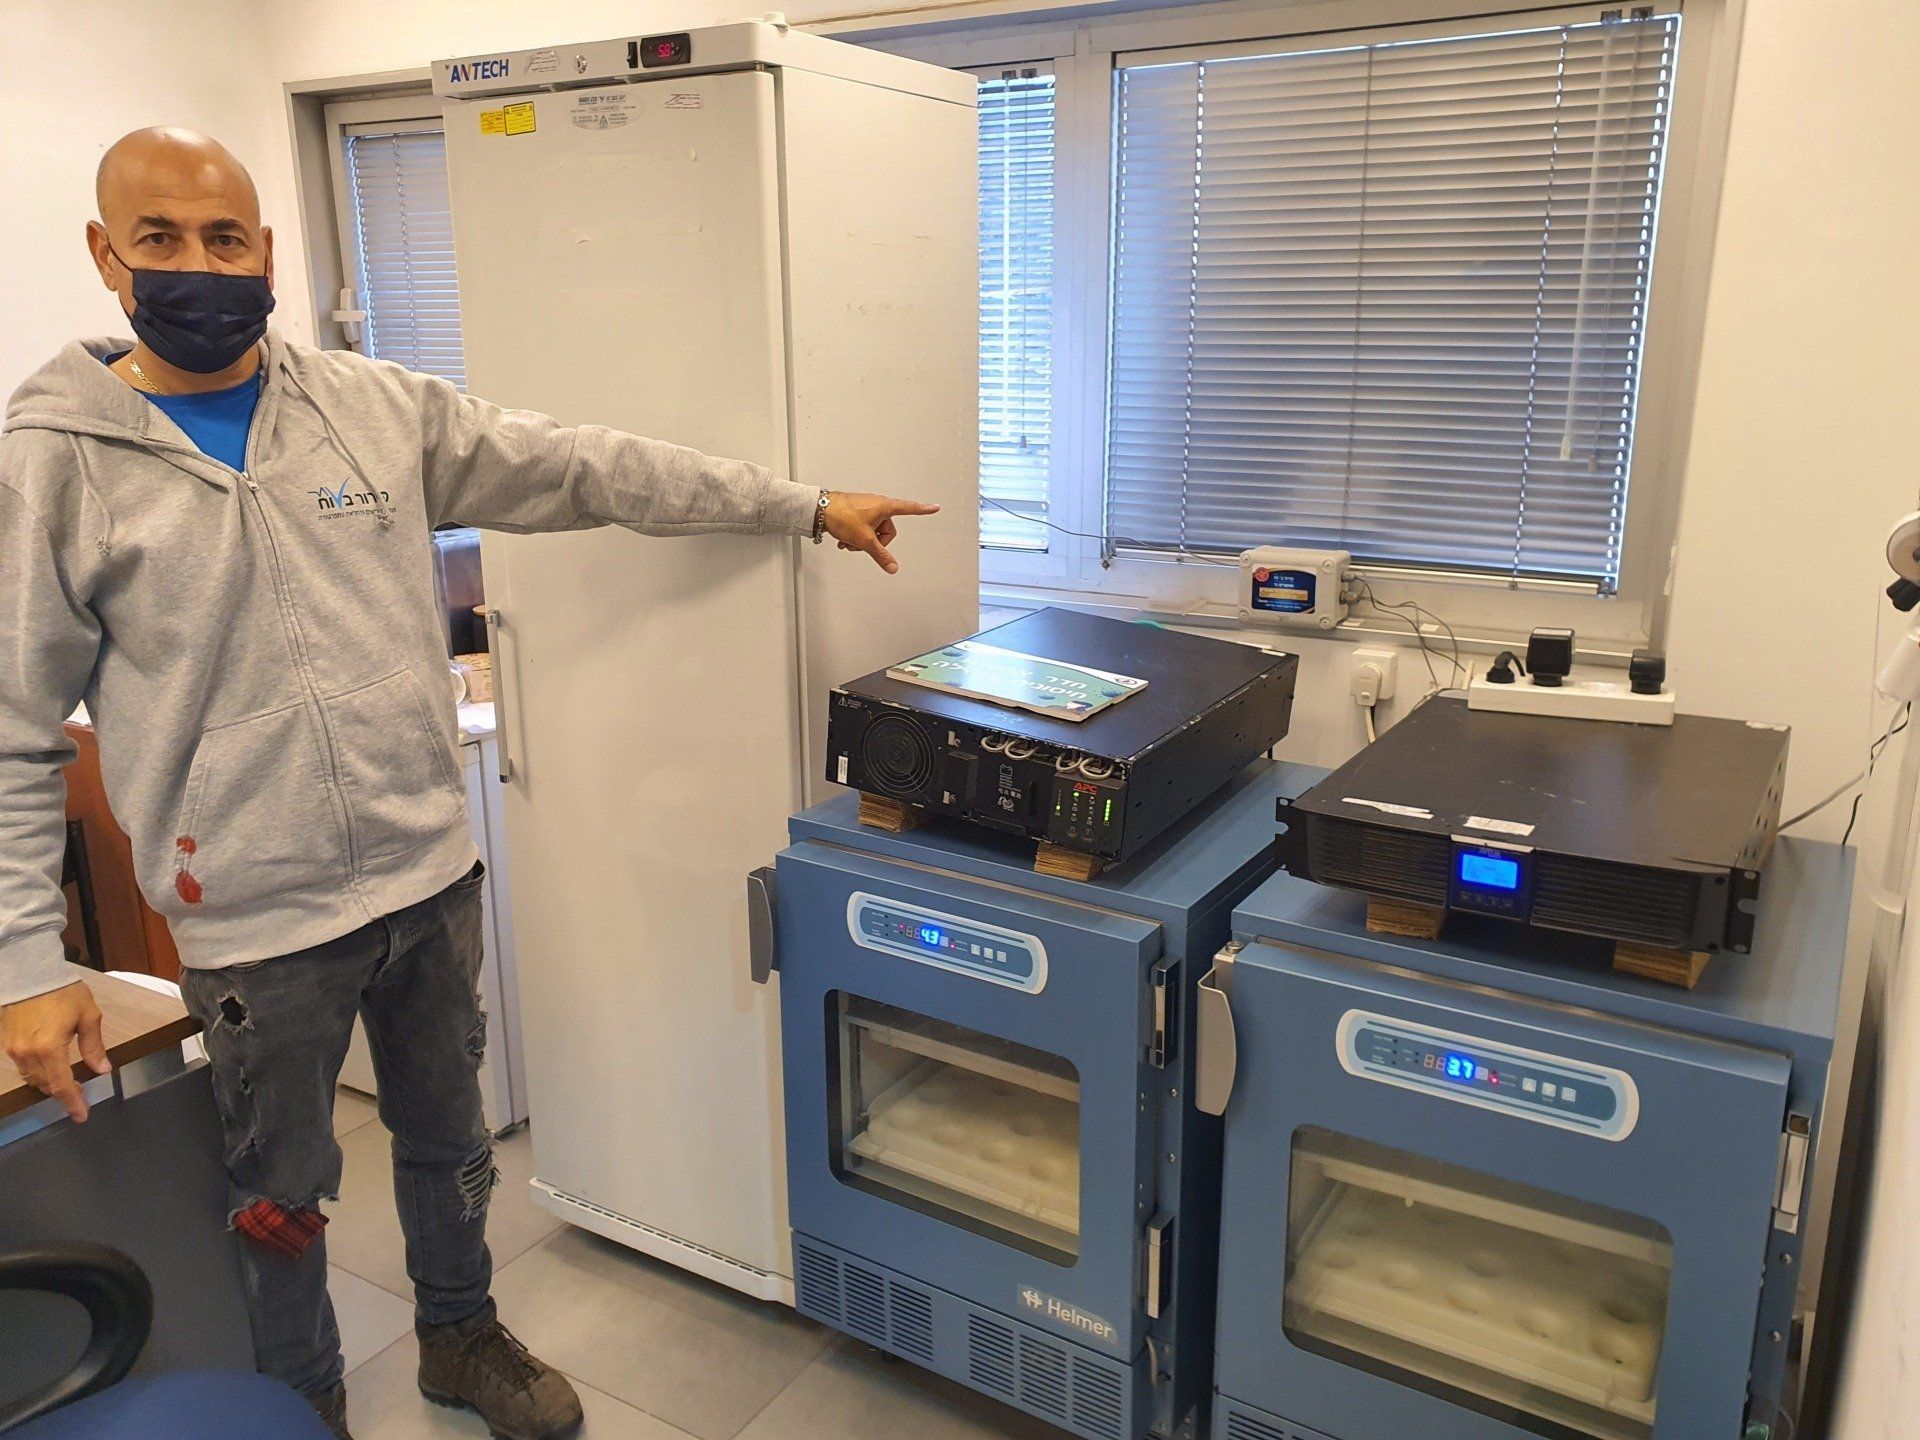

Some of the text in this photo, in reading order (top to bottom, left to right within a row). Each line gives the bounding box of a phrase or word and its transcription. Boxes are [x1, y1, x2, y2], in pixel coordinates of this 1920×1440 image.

[1045, 675, 1088, 689] חדר
[1074, 782, 1098, 795] APC
[1047, 1298, 1112, 1338] Helmer
